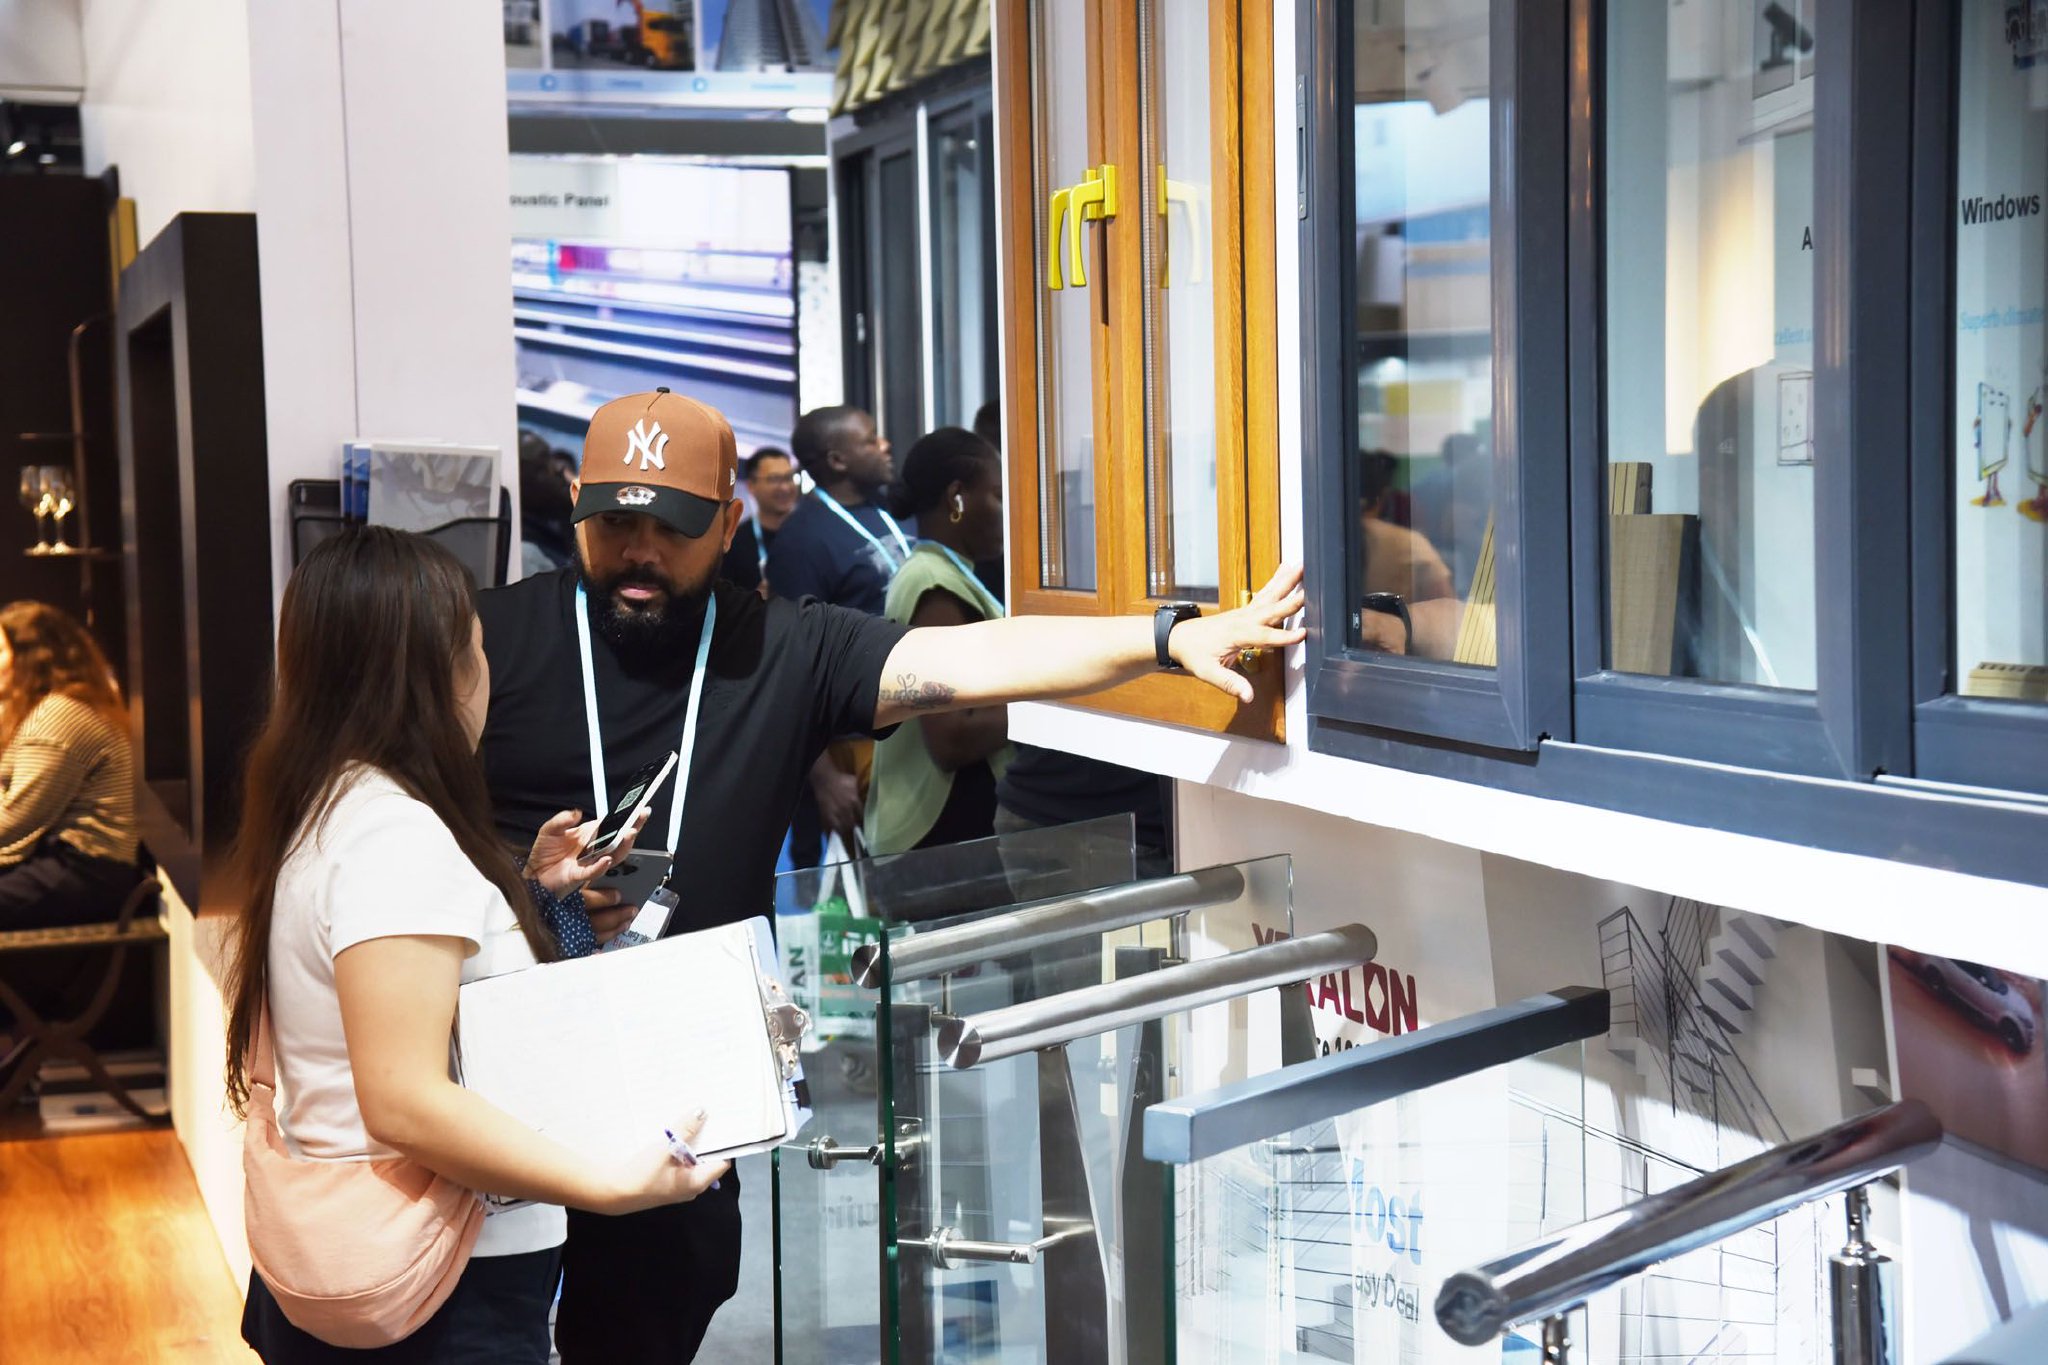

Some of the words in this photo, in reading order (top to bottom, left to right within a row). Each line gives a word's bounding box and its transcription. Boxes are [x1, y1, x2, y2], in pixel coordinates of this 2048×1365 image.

[563, 192, 609, 208] Panel
[1961, 194, 2041, 225] Windows
[623, 418, 669, 471] NY
[1383, 1272, 1419, 1324] Deal
